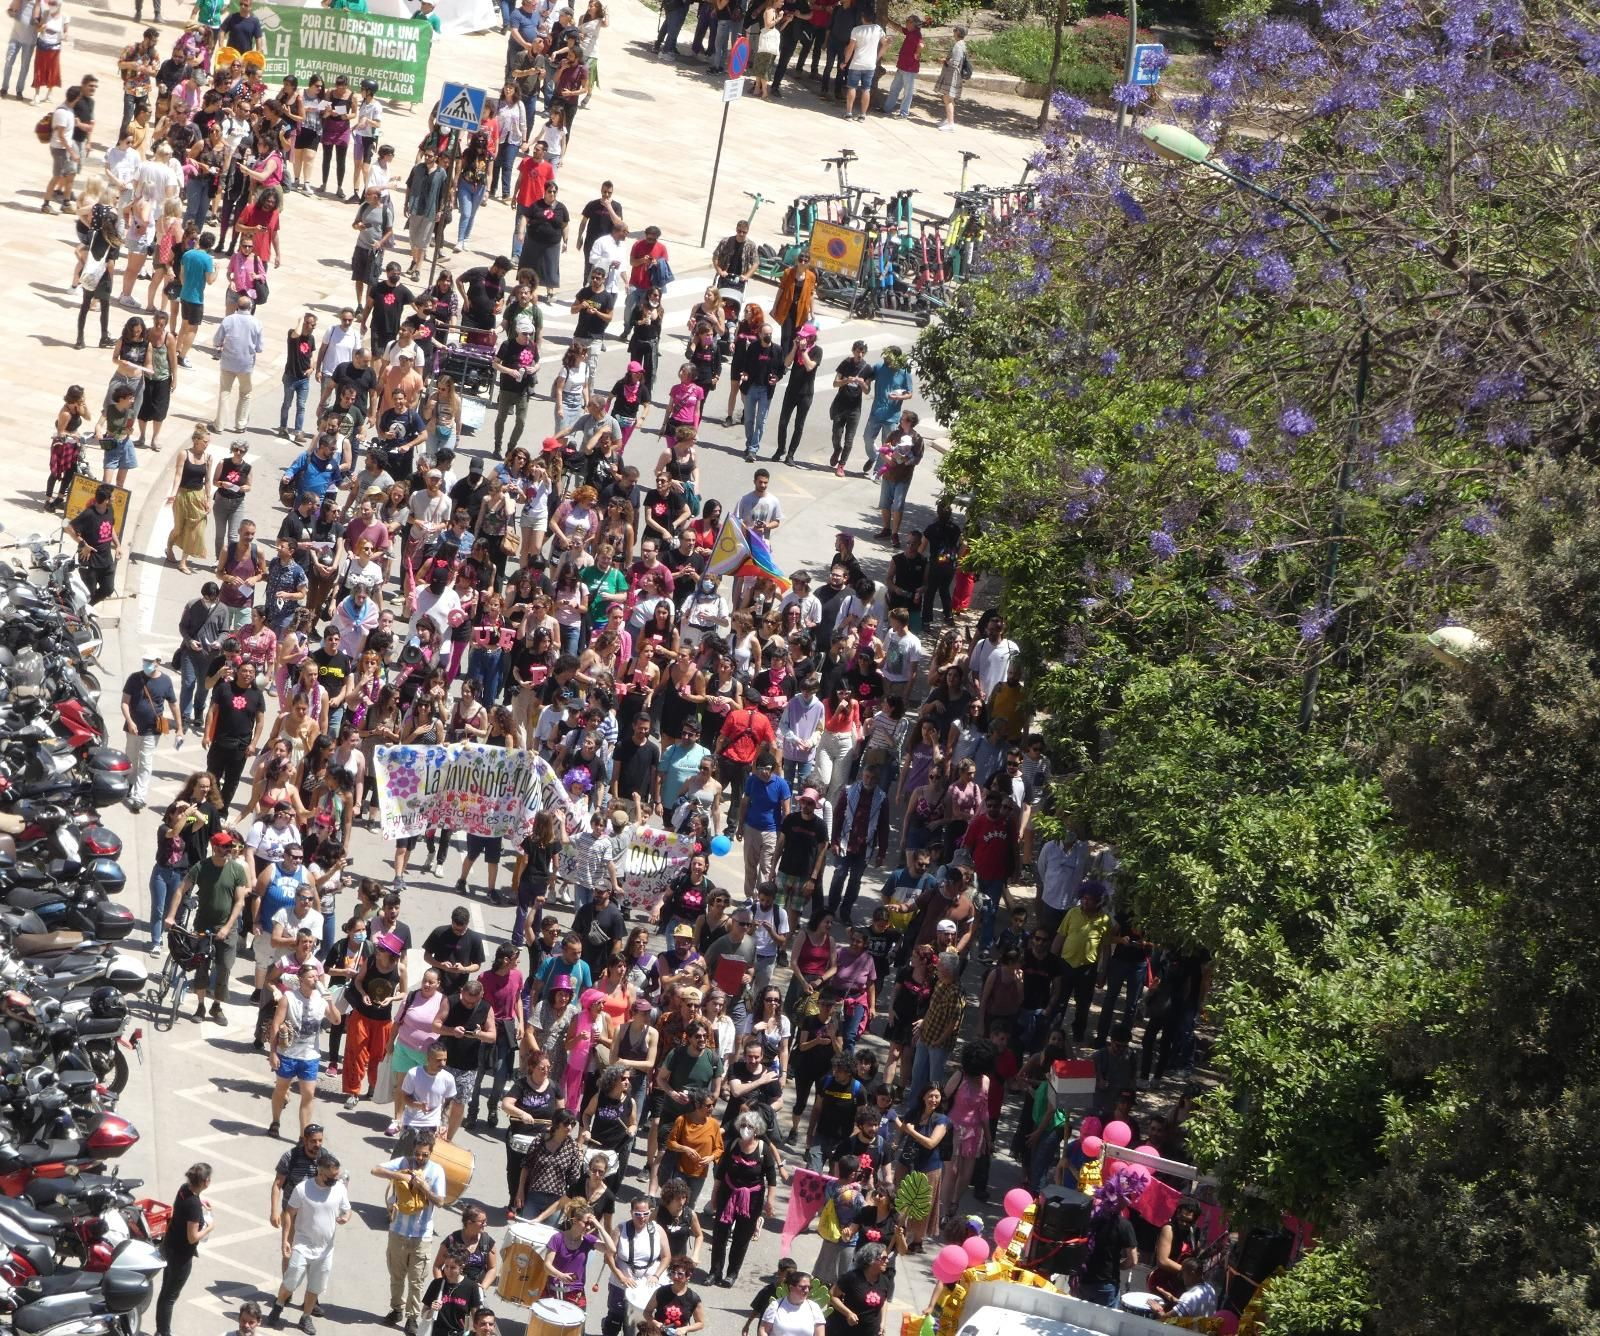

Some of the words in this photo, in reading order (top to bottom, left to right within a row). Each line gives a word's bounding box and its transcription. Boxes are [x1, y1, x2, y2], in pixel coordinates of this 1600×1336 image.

[301, 13, 321, 29] POR
[324, 15, 336, 30] EL
[339, 17, 384, 37] DERECHO
[386, 24, 394, 38] A
[398, 25, 420, 42] UNA
[300, 28, 367, 56] VIVIENDA
[372, 38, 417, 63] DIGNA
[295, 58, 352, 75] PLATAFORMA
[354, 66, 366, 76] DE
[366, 69, 416, 84] AFECTADOS
[424, 764, 440, 796] La
[443, 761, 509, 799] Invisible
[432, 806, 499, 825] residentes
[502, 813, 516, 823] en
[630, 844, 669, 880] CASA
